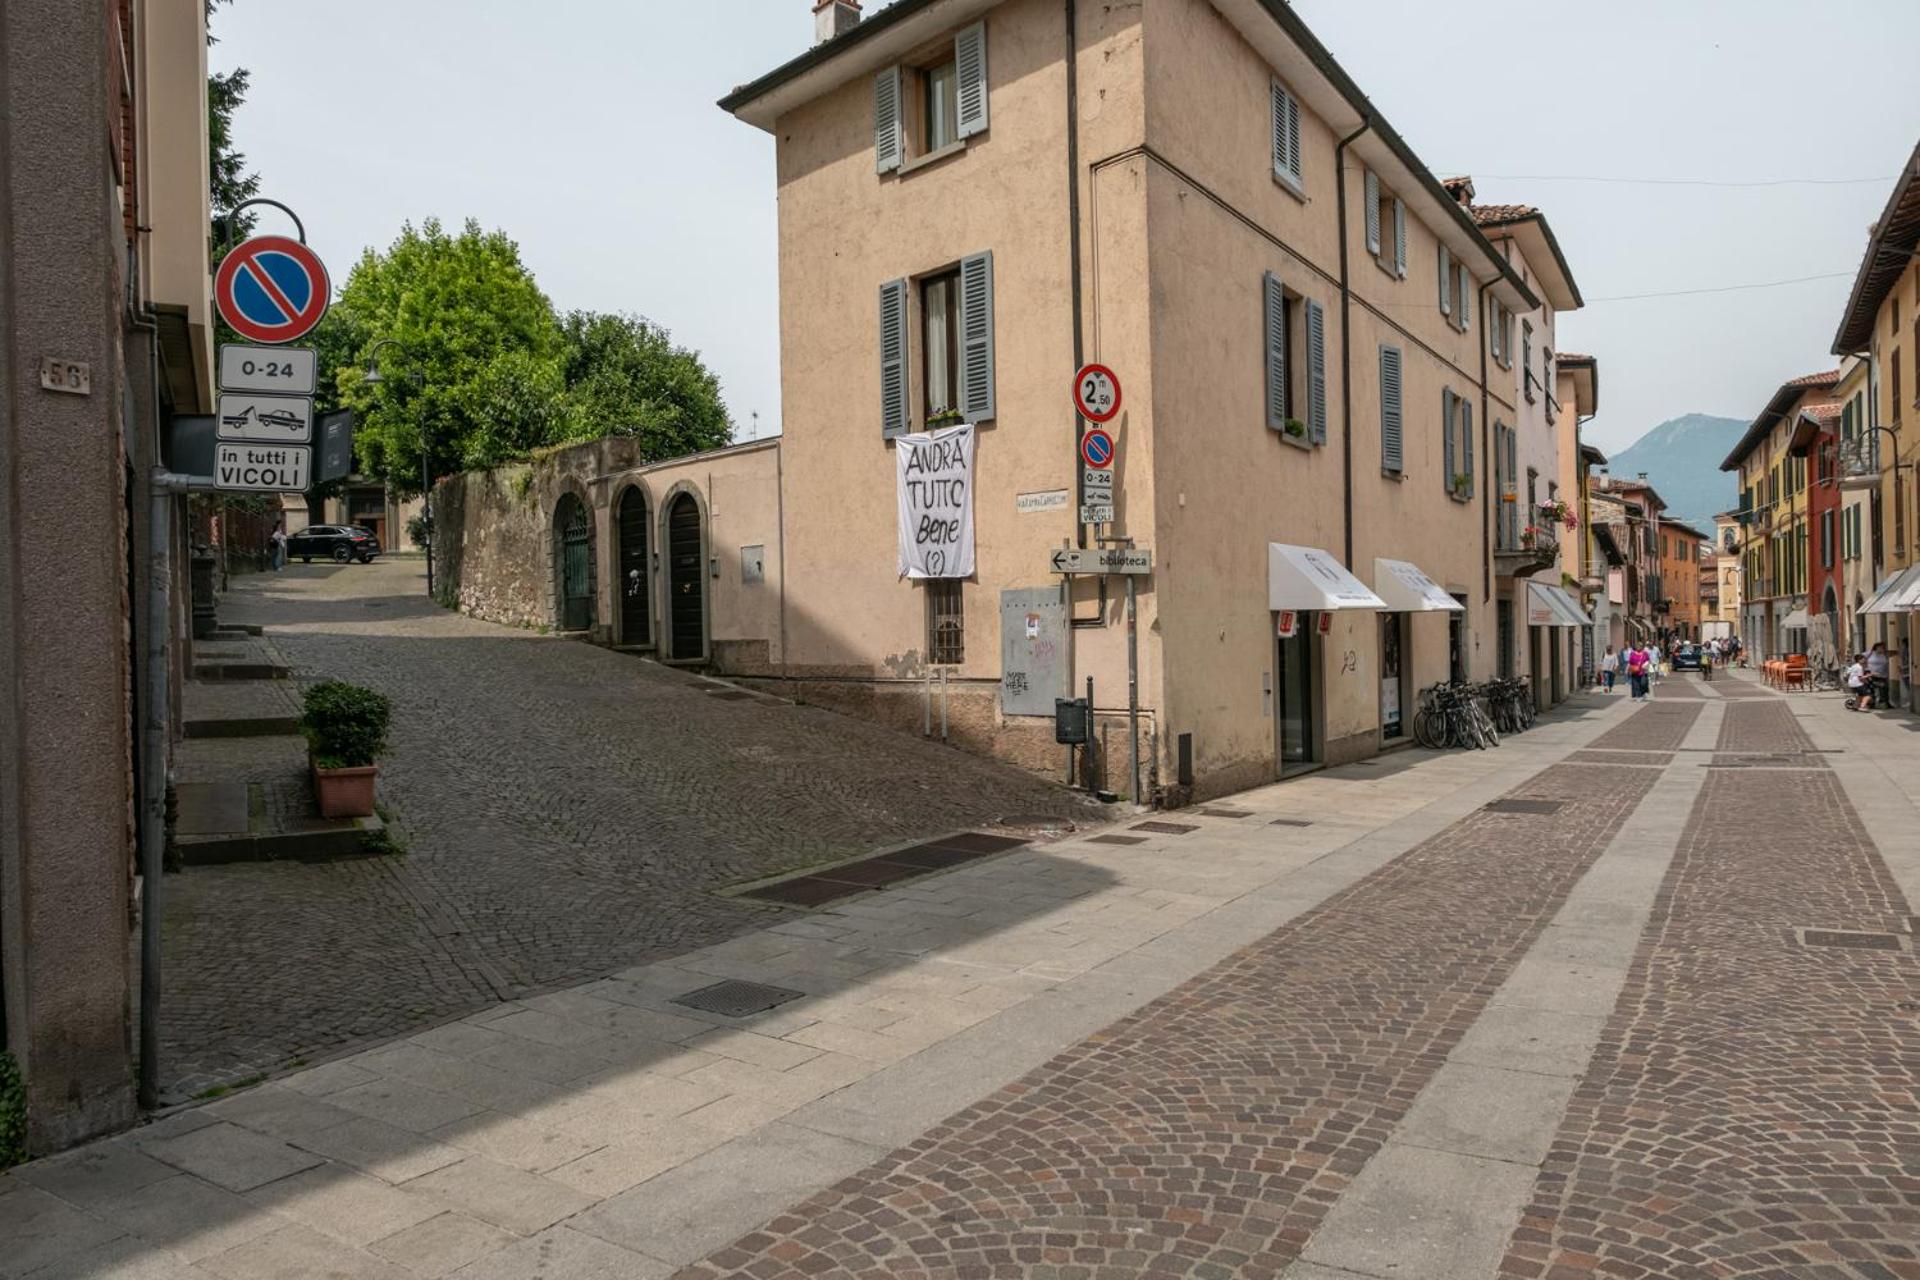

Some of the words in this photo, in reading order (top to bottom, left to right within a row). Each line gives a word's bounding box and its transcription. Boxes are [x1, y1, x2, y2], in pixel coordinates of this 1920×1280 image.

[242, 360, 294, 378] 0-24
[222, 449, 238, 463] in
[247, 450, 286, 465] tutti
[295, 452, 300, 465] i
[221, 467, 298, 486] VICOLI
[1099, 555, 1147, 567] biblioteca
